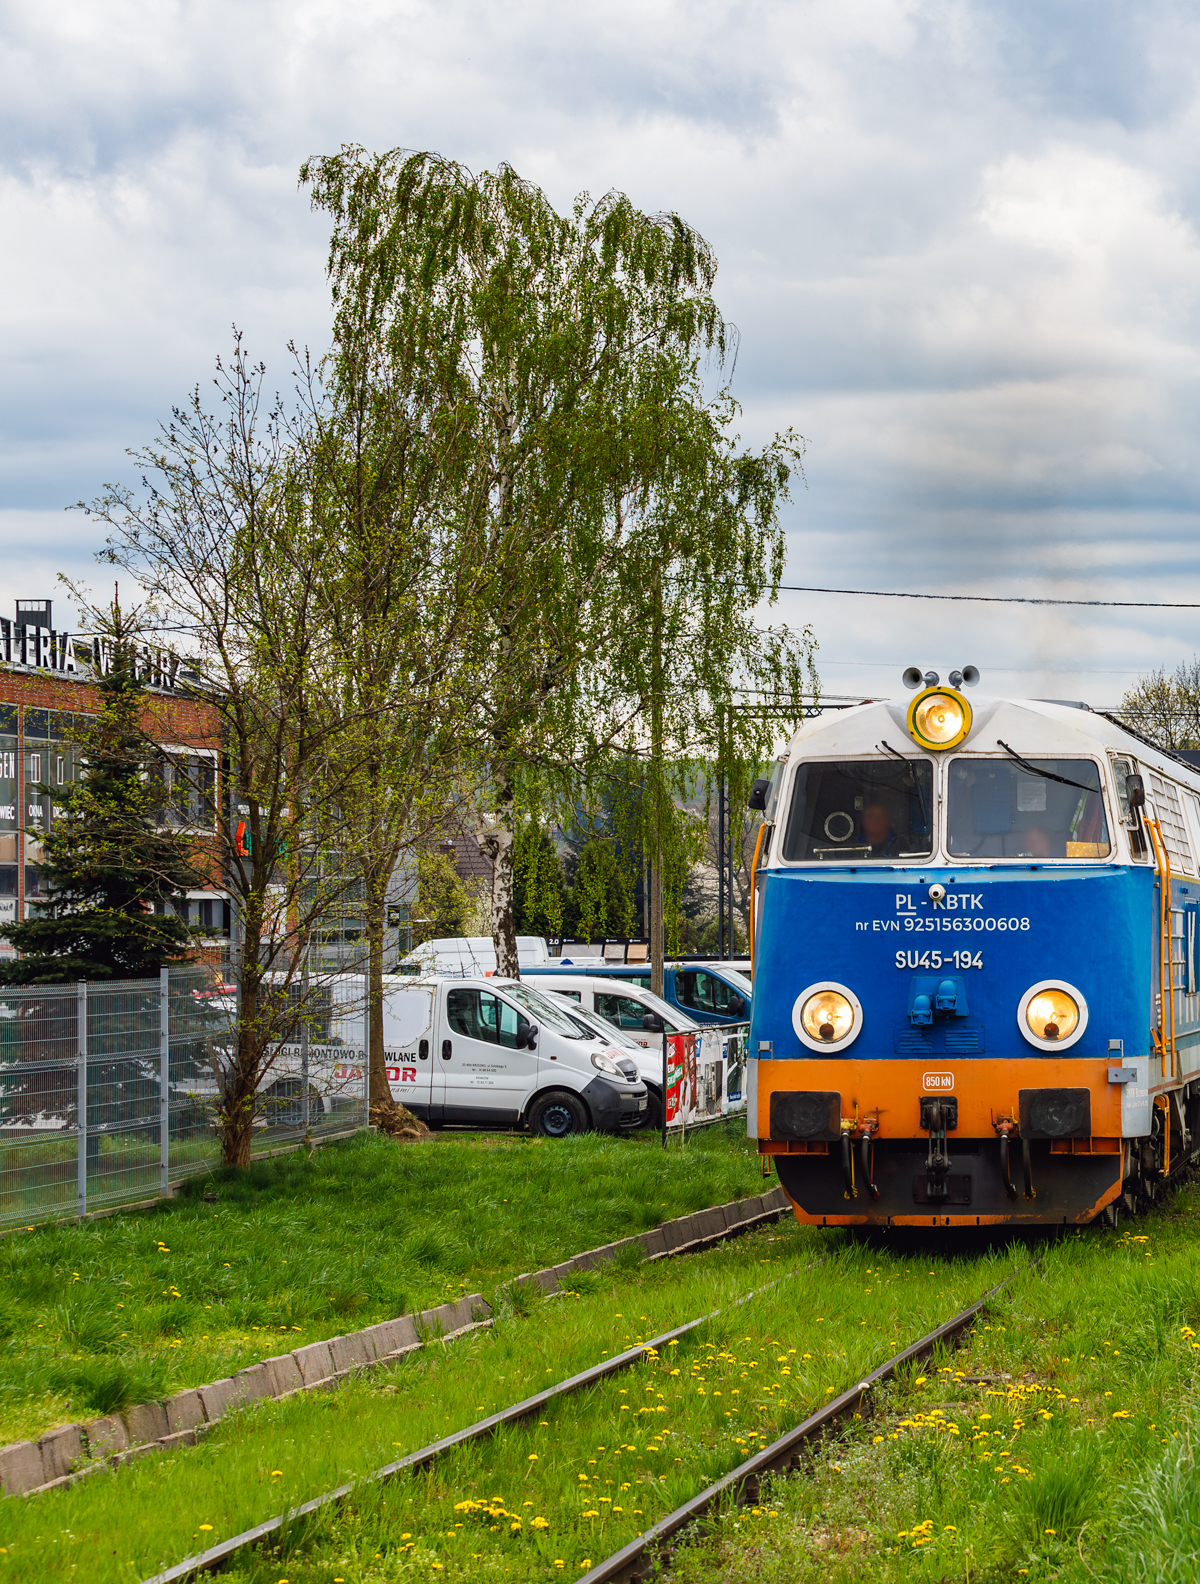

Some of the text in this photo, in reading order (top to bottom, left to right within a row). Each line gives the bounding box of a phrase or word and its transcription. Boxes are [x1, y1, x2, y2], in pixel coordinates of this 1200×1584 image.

[28, 804, 44, 818] OKNA
[895, 894, 917, 910] PL
[933, 894, 984, 910] KBTK
[855, 917, 1031, 932] nr EVN 925156300608
[895, 950, 983, 970] SU45-194
[925, 1076, 951, 1087] 850 kN
